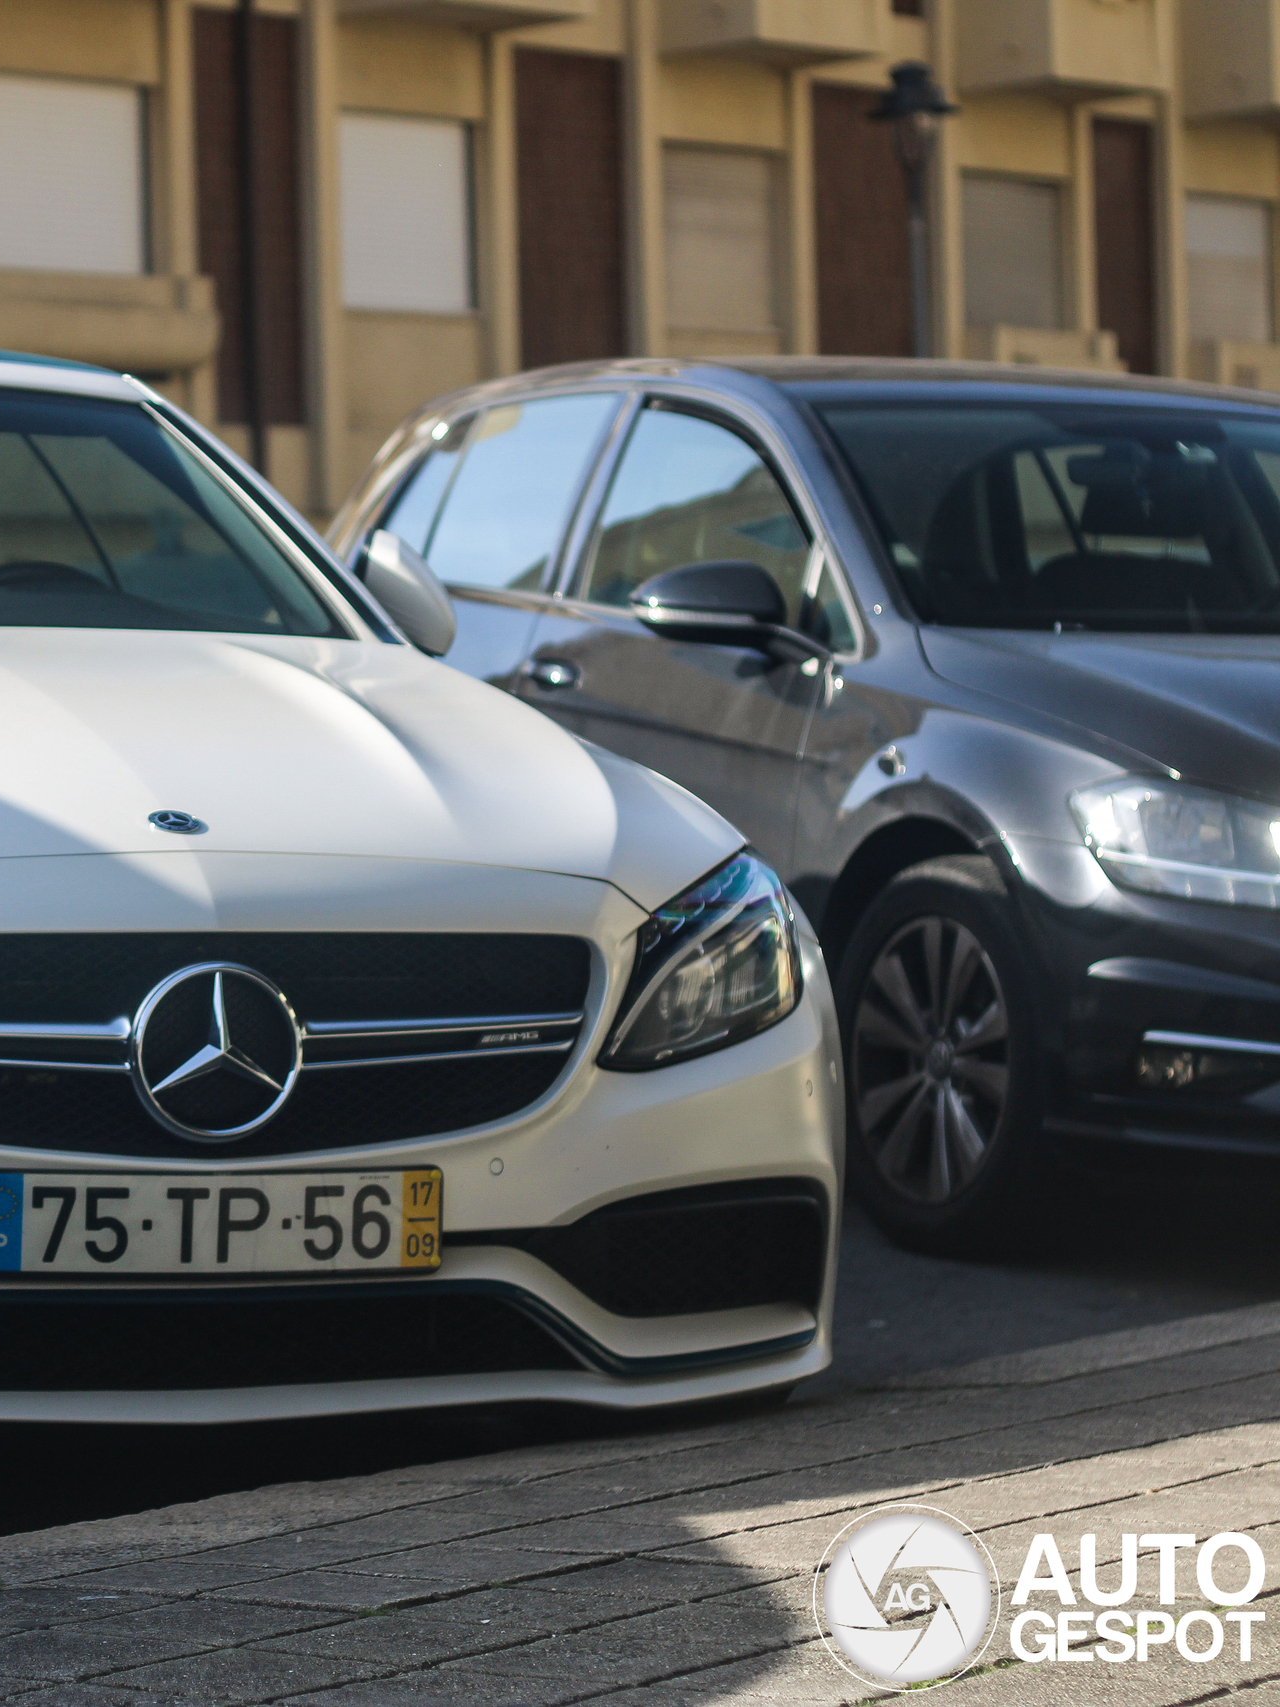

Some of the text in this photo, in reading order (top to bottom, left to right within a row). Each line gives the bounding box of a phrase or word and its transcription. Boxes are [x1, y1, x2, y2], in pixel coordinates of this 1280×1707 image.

[499, 1031, 539, 1042] AMG
[410, 1181, 433, 1206] 17
[406, 1233, 435, 1257] 09
